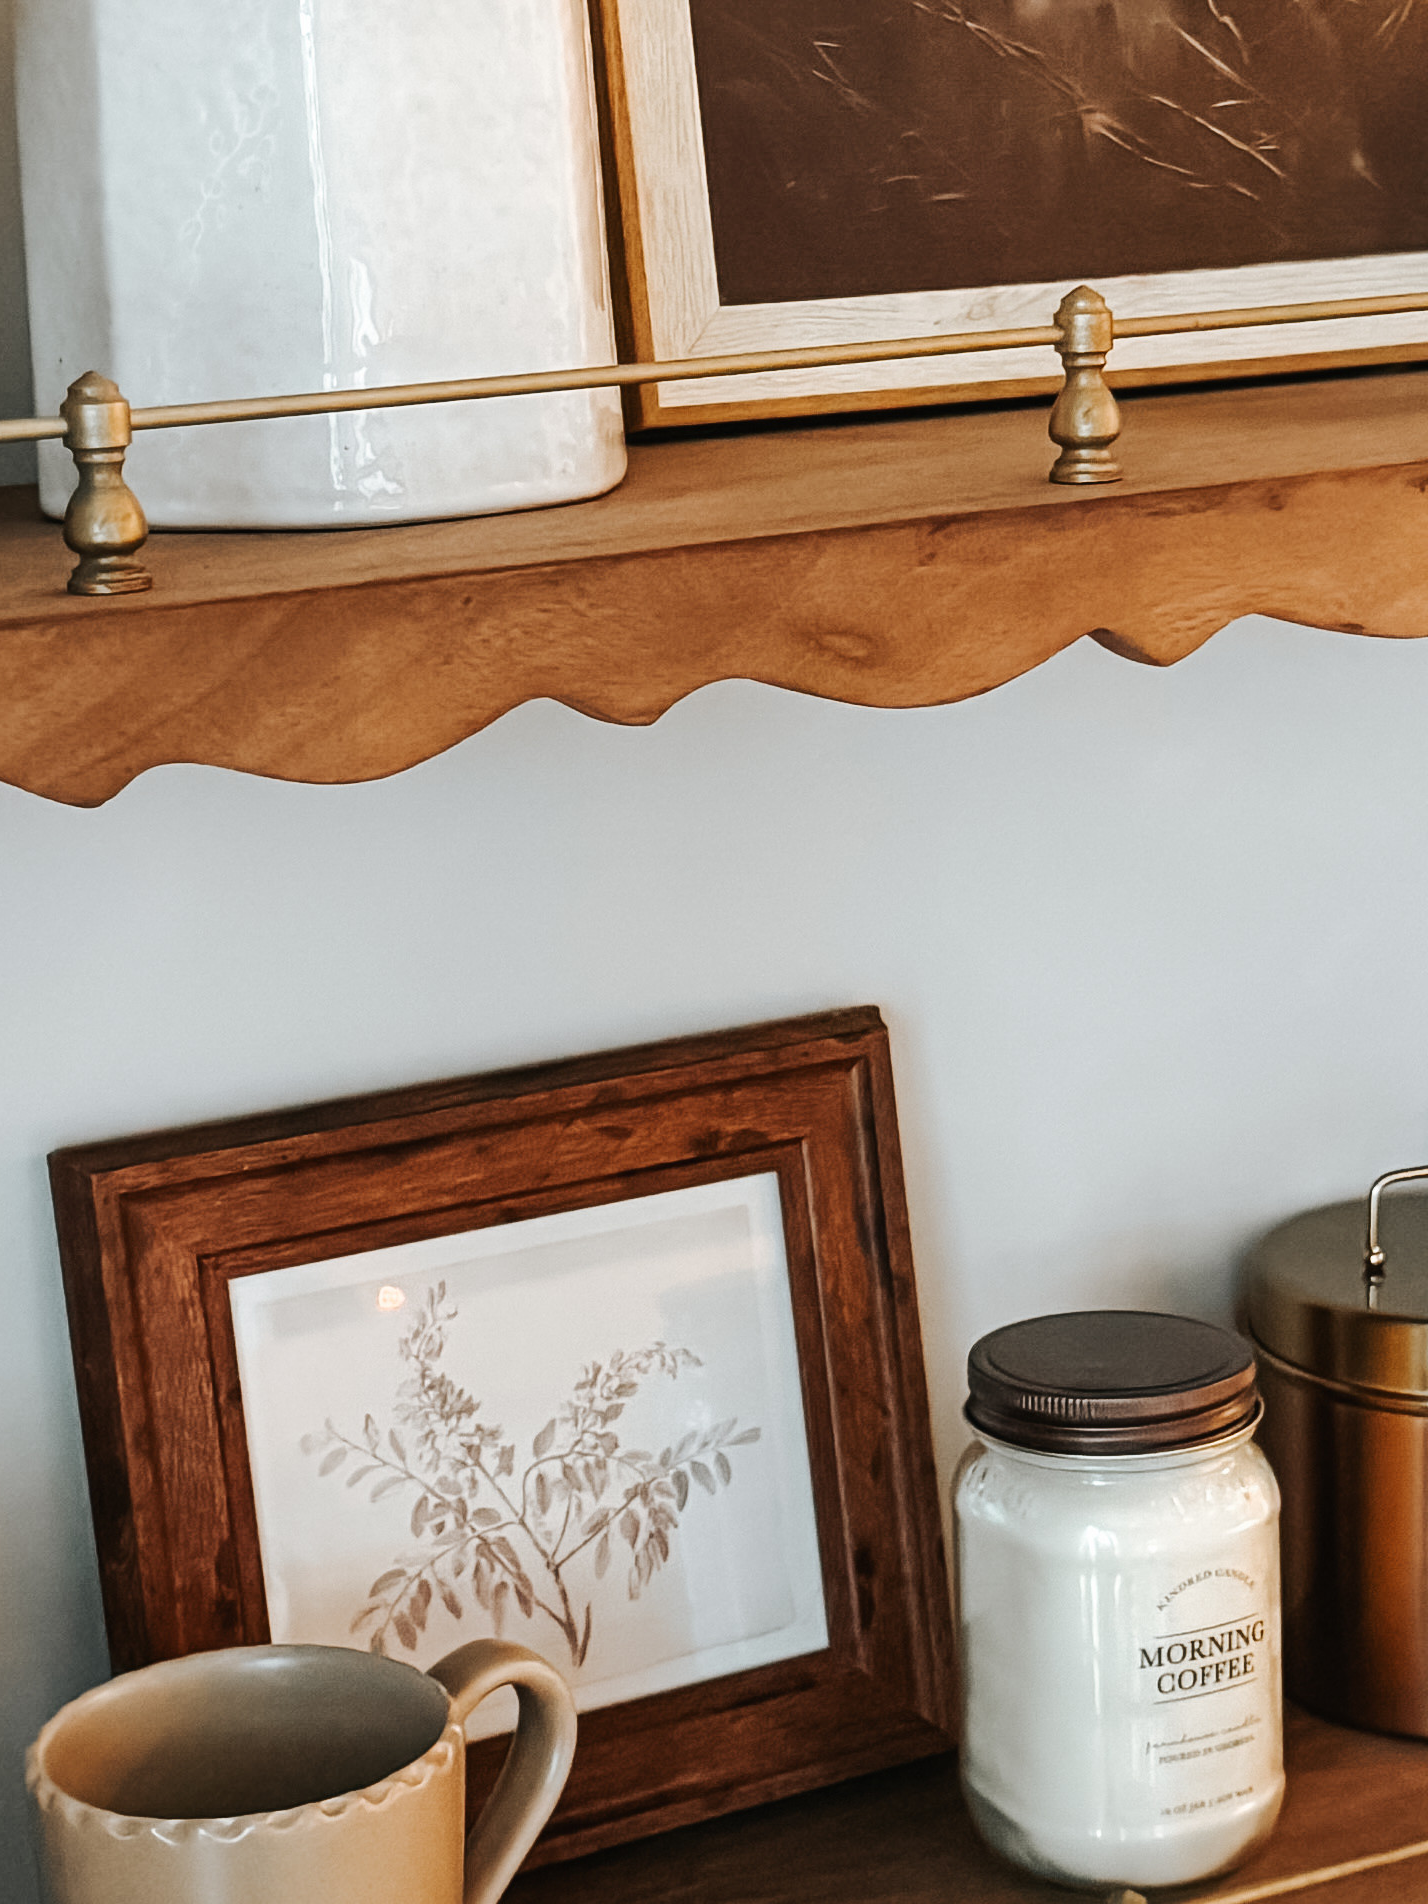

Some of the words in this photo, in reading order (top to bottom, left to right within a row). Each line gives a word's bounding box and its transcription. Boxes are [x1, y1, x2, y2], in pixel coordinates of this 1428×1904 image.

[1156, 1570, 1212, 1611] KINDRED
[1139, 1620, 1264, 1669] MORNING
[1157, 1653, 1255, 1694] COFFEE
